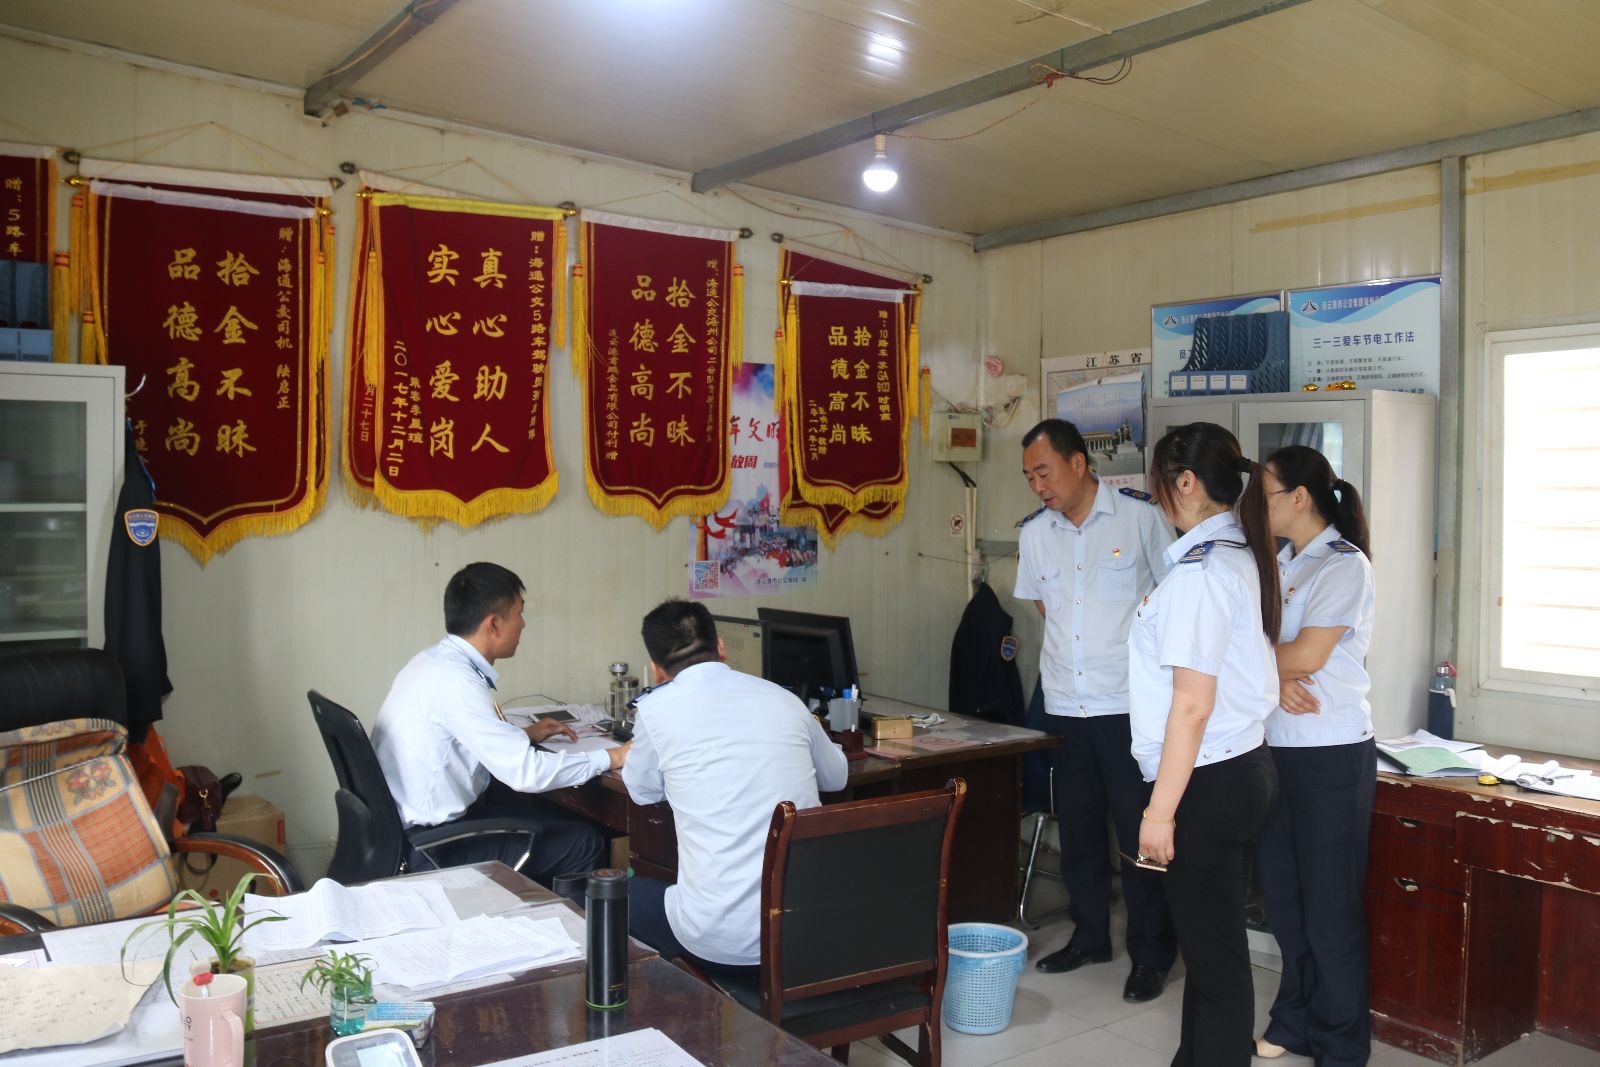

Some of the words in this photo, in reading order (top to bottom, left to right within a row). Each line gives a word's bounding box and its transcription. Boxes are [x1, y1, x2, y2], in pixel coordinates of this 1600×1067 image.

[162, 247, 203, 457] 品德高尚
[214, 250, 260, 458] 拾金不昧
[387, 340, 409, 477] 二〇一七年十二月二日
[425, 243, 461, 460] 实心爱岗
[471, 247, 510, 453] 真心助人
[629, 274, 659, 448] 品德高尚
[665, 276, 697, 447] 拾金不昧
[828, 325, 850, 445] 品德高尚
[851, 325, 873, 444] 拾金不昧
[1085, 352, 1143, 368] 江苏省
[1313, 331, 1415, 349] 三一三爱车节电工作法
